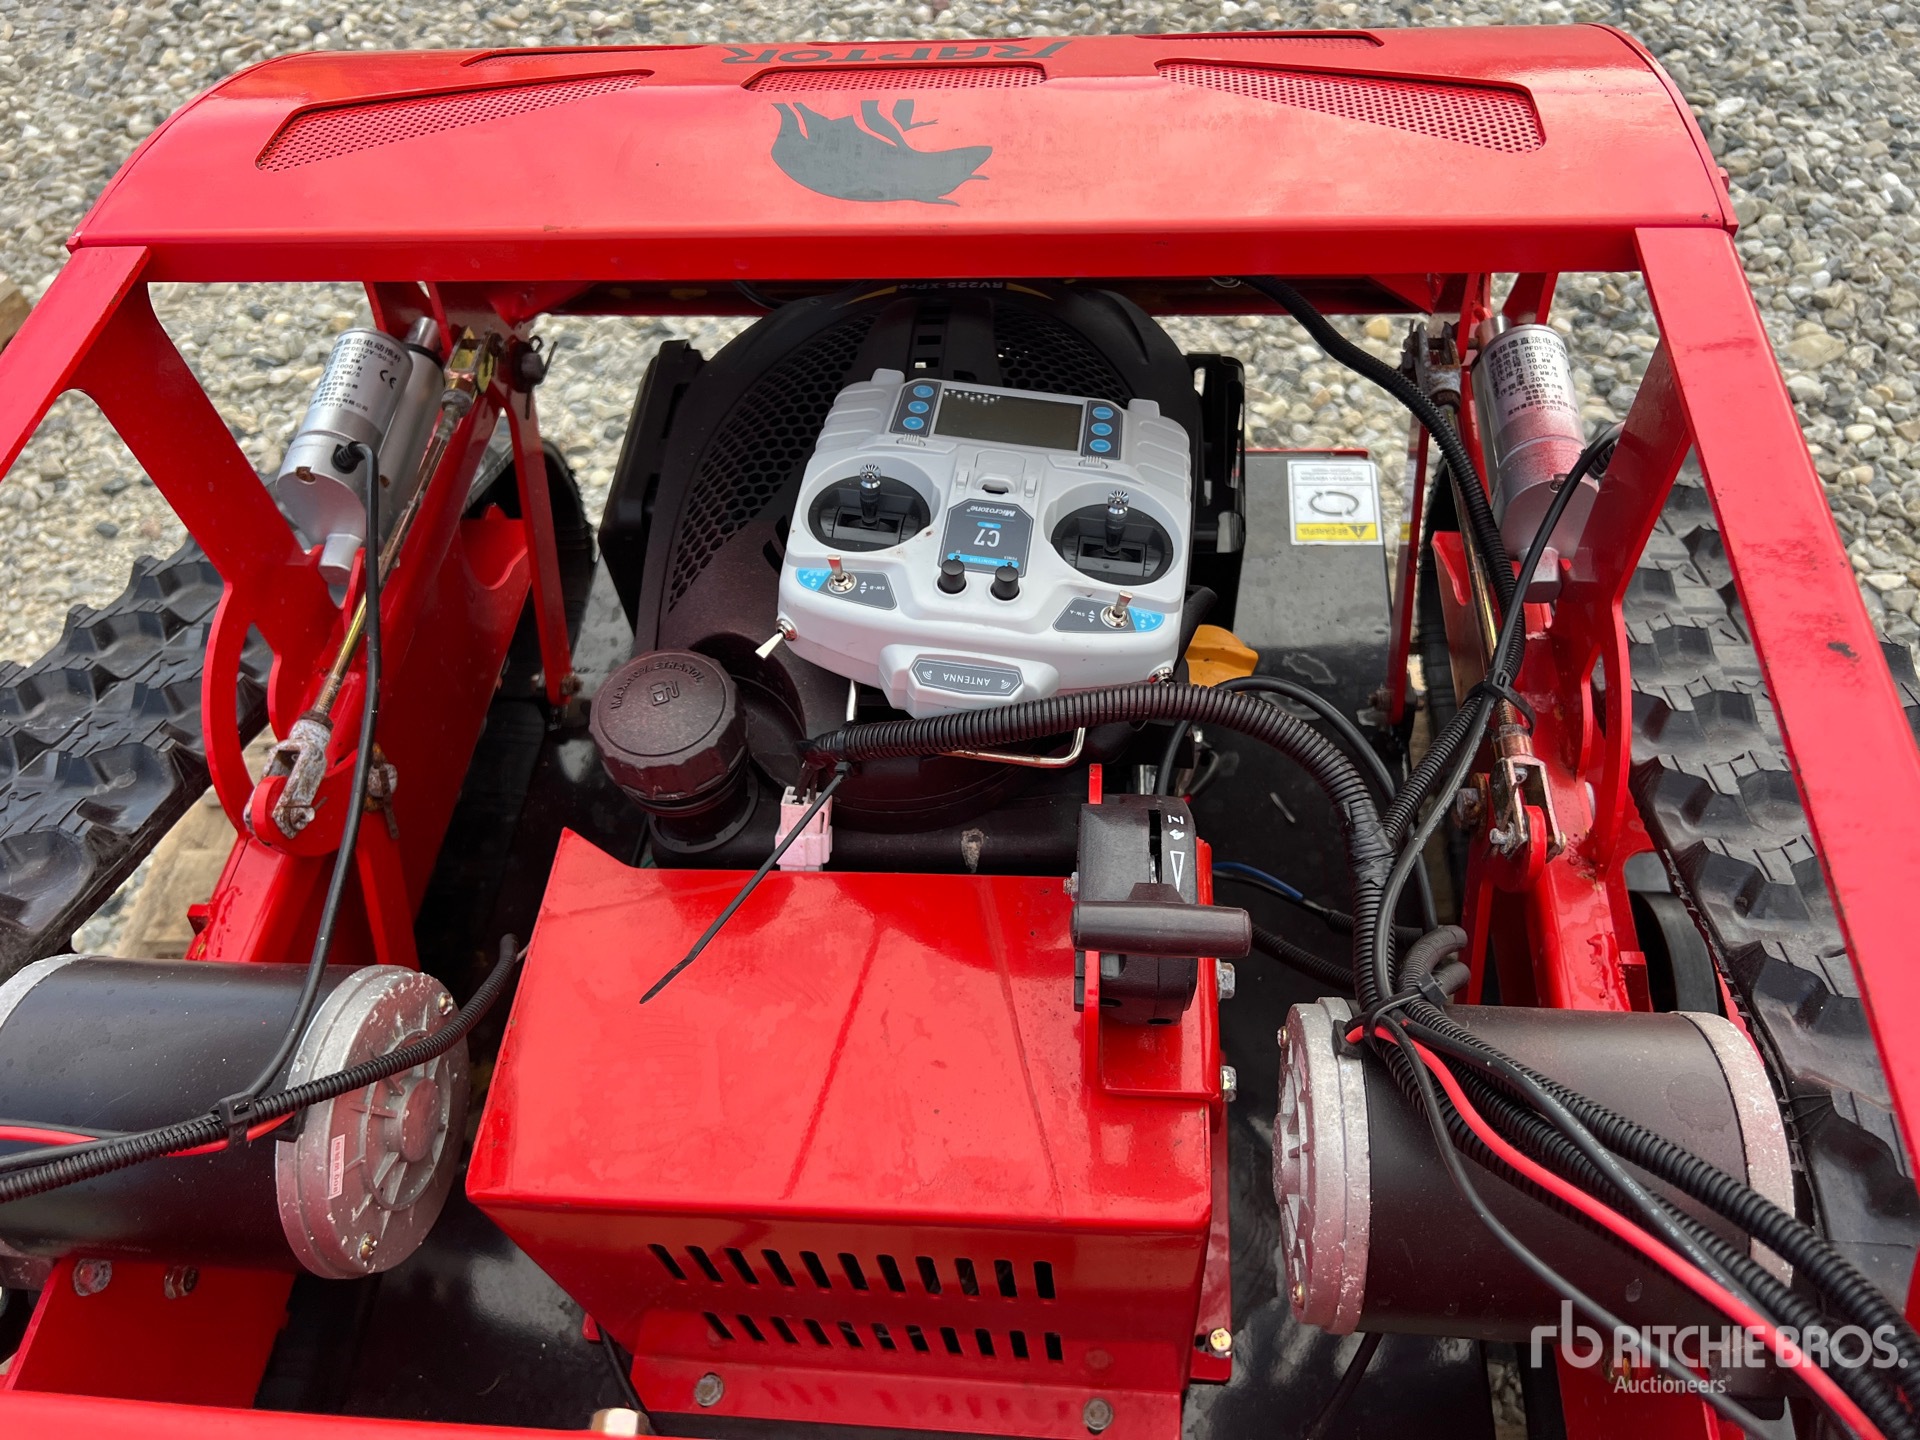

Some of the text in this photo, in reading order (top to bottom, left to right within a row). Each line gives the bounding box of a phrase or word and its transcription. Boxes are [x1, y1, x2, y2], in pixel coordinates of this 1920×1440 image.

[721, 40, 1074, 64] RAPTOR
[970, 506, 1016, 517] Microzone
[974, 529, 1000, 548] C7
[943, 673, 990, 686] ANTENNA
[1622, 1177, 1646, 1200] 300V
